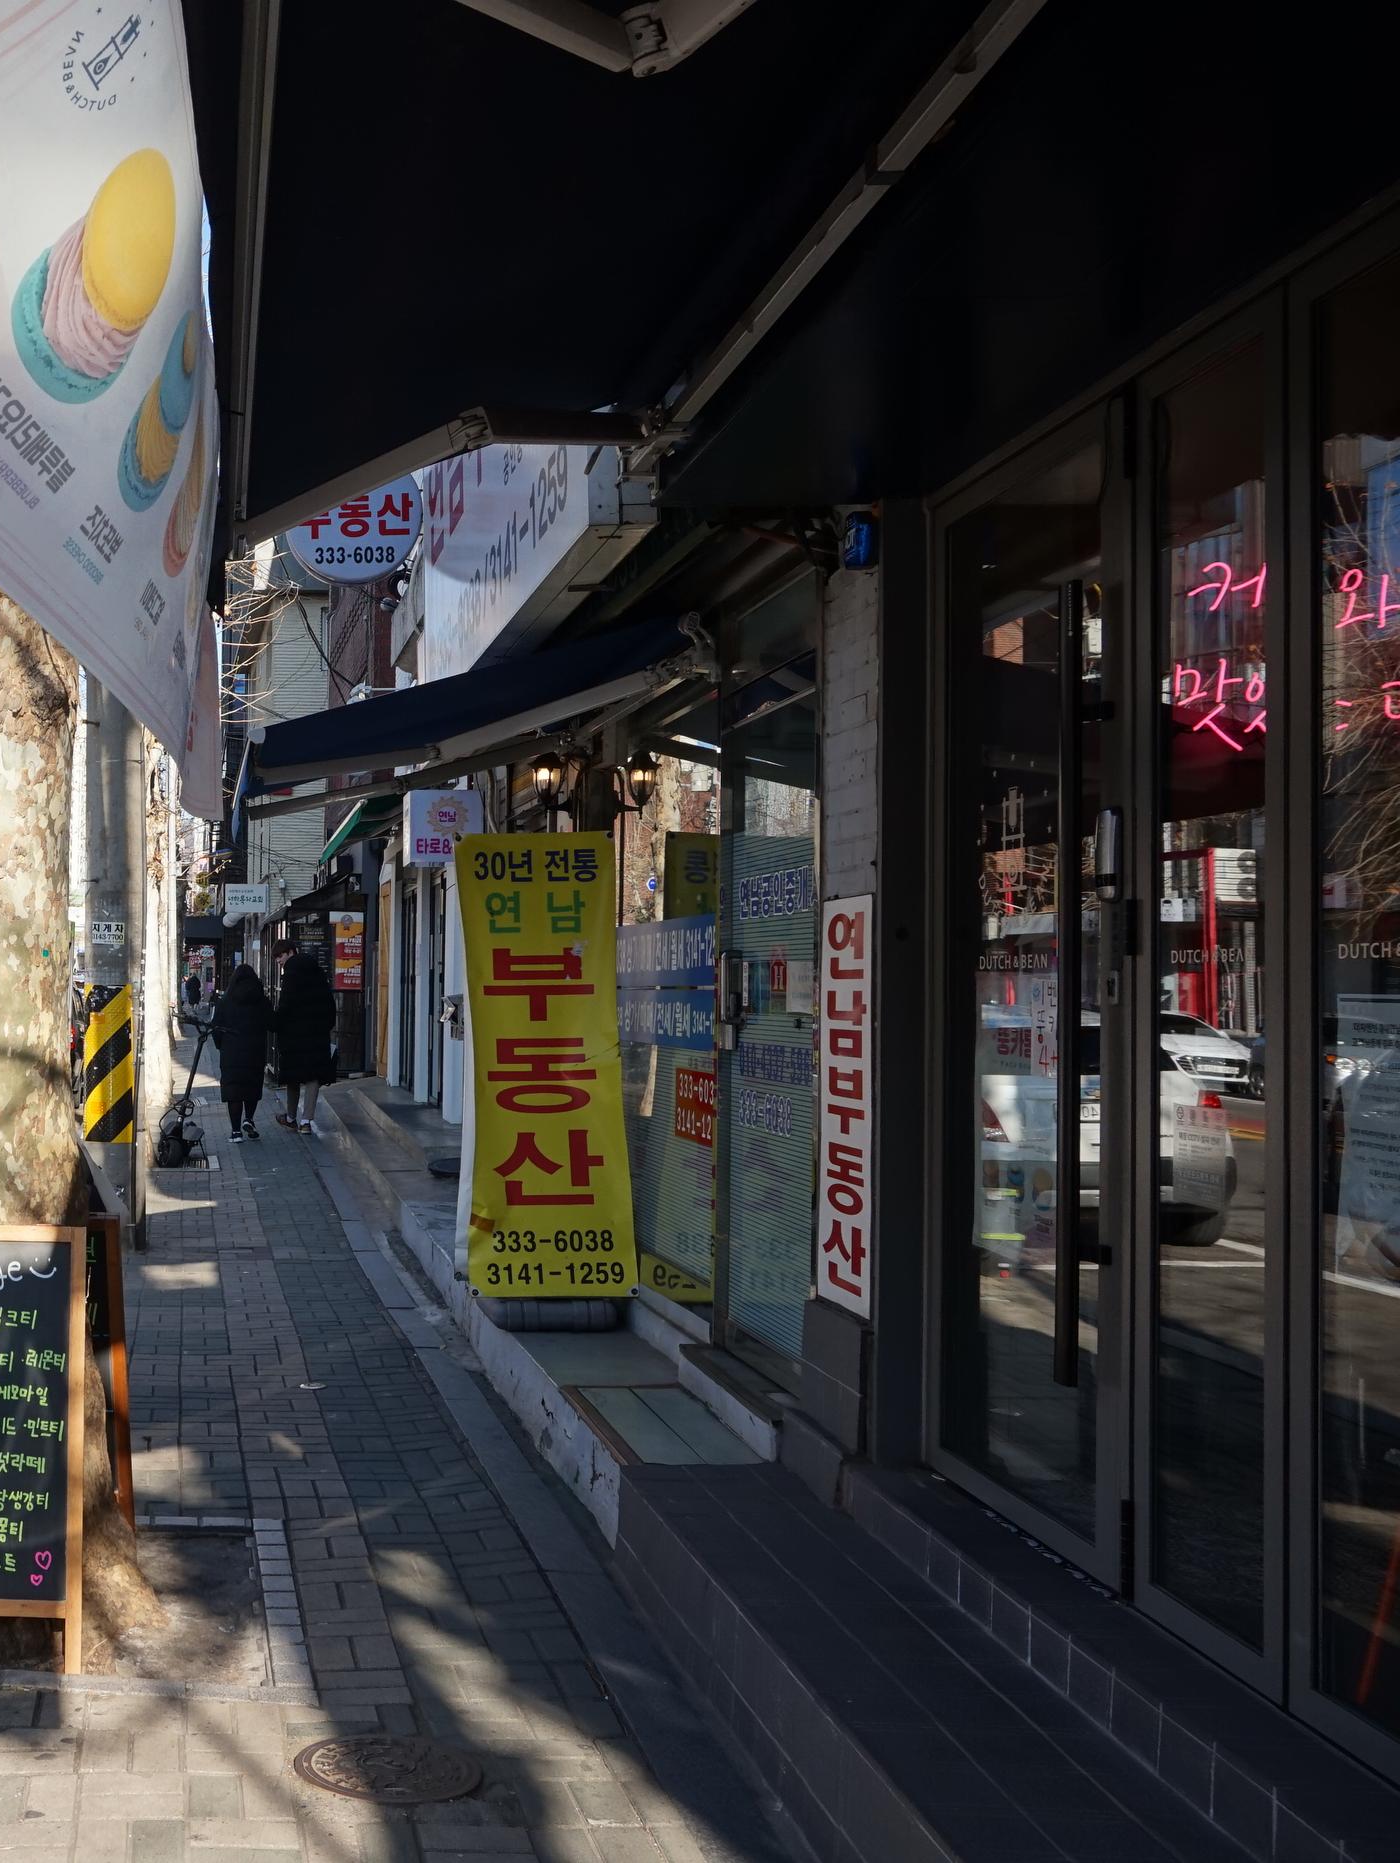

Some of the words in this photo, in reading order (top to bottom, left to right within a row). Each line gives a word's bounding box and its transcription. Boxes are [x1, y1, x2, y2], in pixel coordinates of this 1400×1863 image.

[315, 546, 395, 564] 333-6038
[438, 810, 457, 823] 연남
[474, 850, 532, 882] 30년
[545, 848, 598, 882] 전통
[1338, 942, 1391, 959] DUTCH
[822, 911, 867, 1298] 연남부동산
[493, 1230, 615, 1253] 333-6038
[487, 1262, 625, 1285] 3141-1259
[28, 1418, 64, 1441] 민트티
